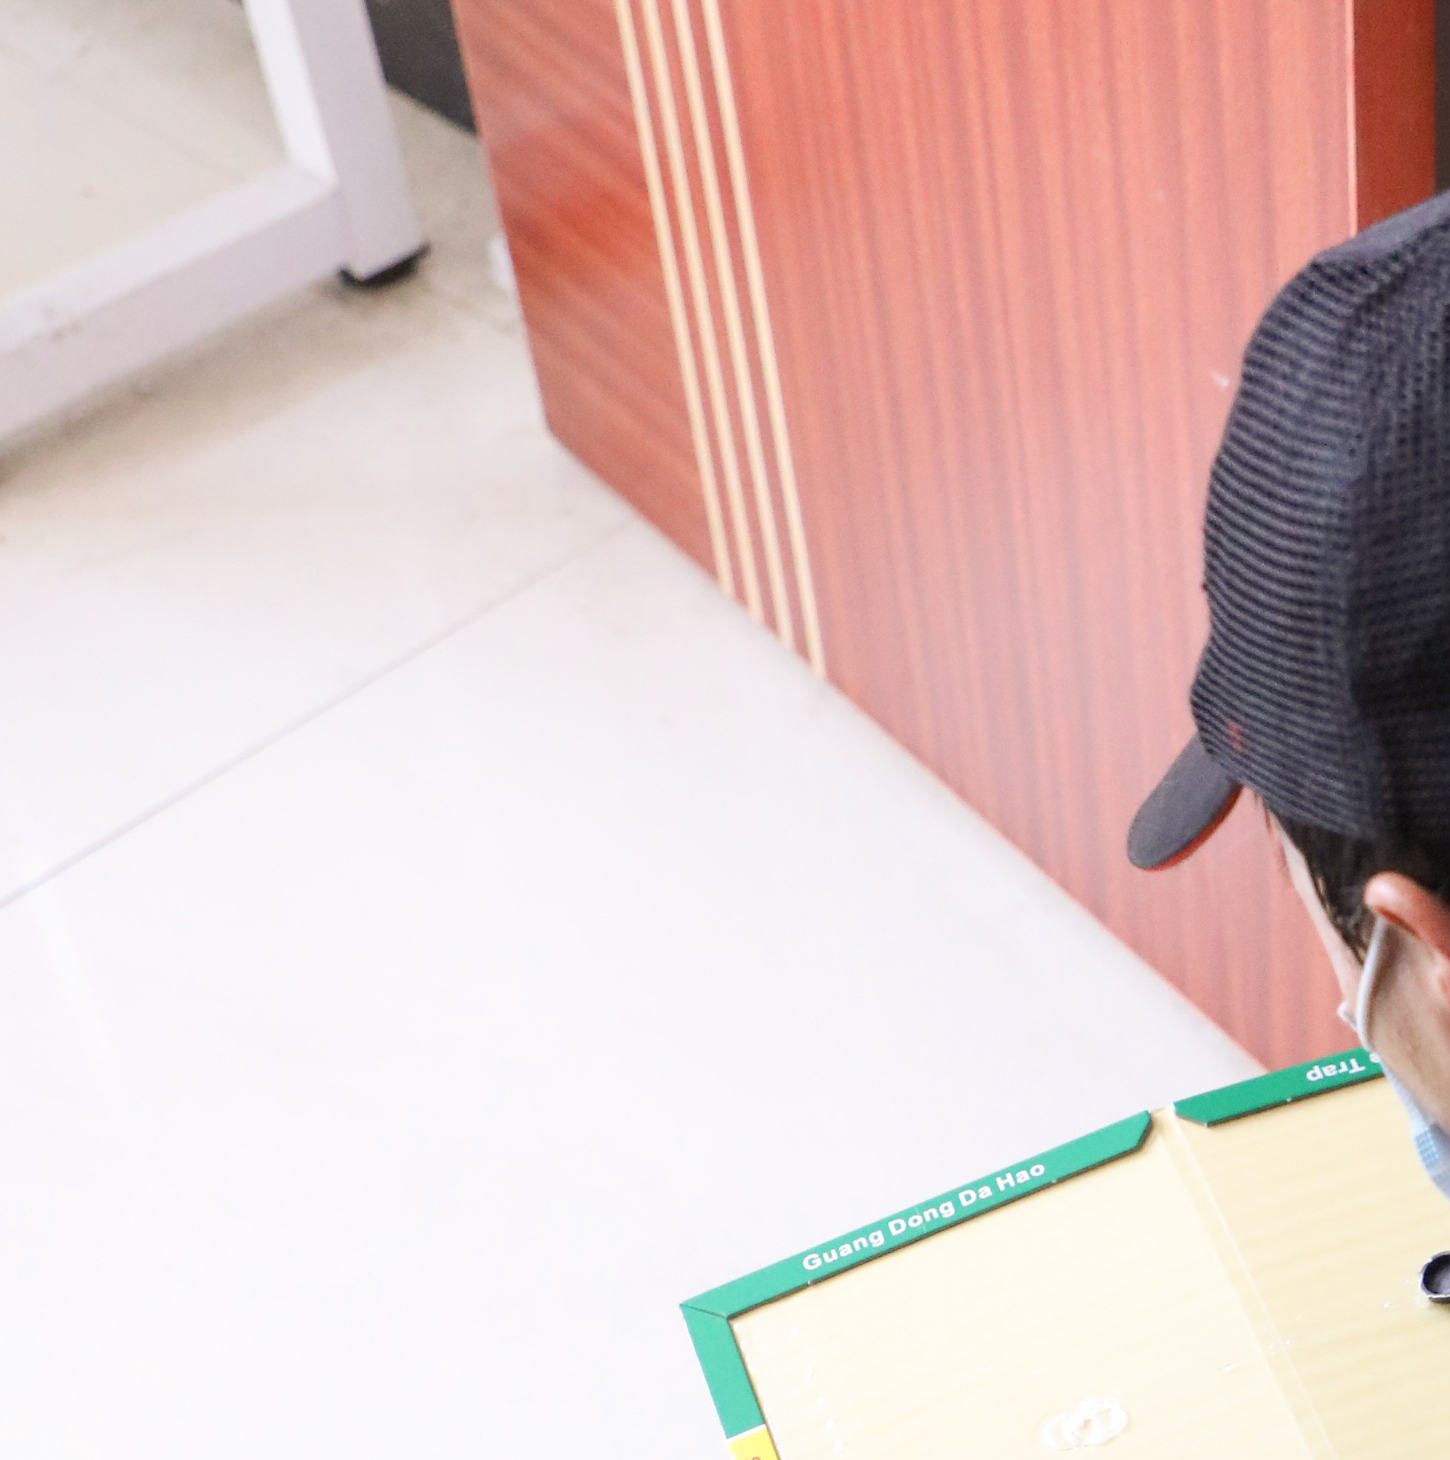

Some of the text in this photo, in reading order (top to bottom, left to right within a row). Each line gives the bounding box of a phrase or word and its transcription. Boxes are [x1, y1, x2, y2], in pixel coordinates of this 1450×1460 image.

[1305, 1057, 1367, 1081] Trap
[803, 1163, 1045, 1269] Guang Dong Da Hao
